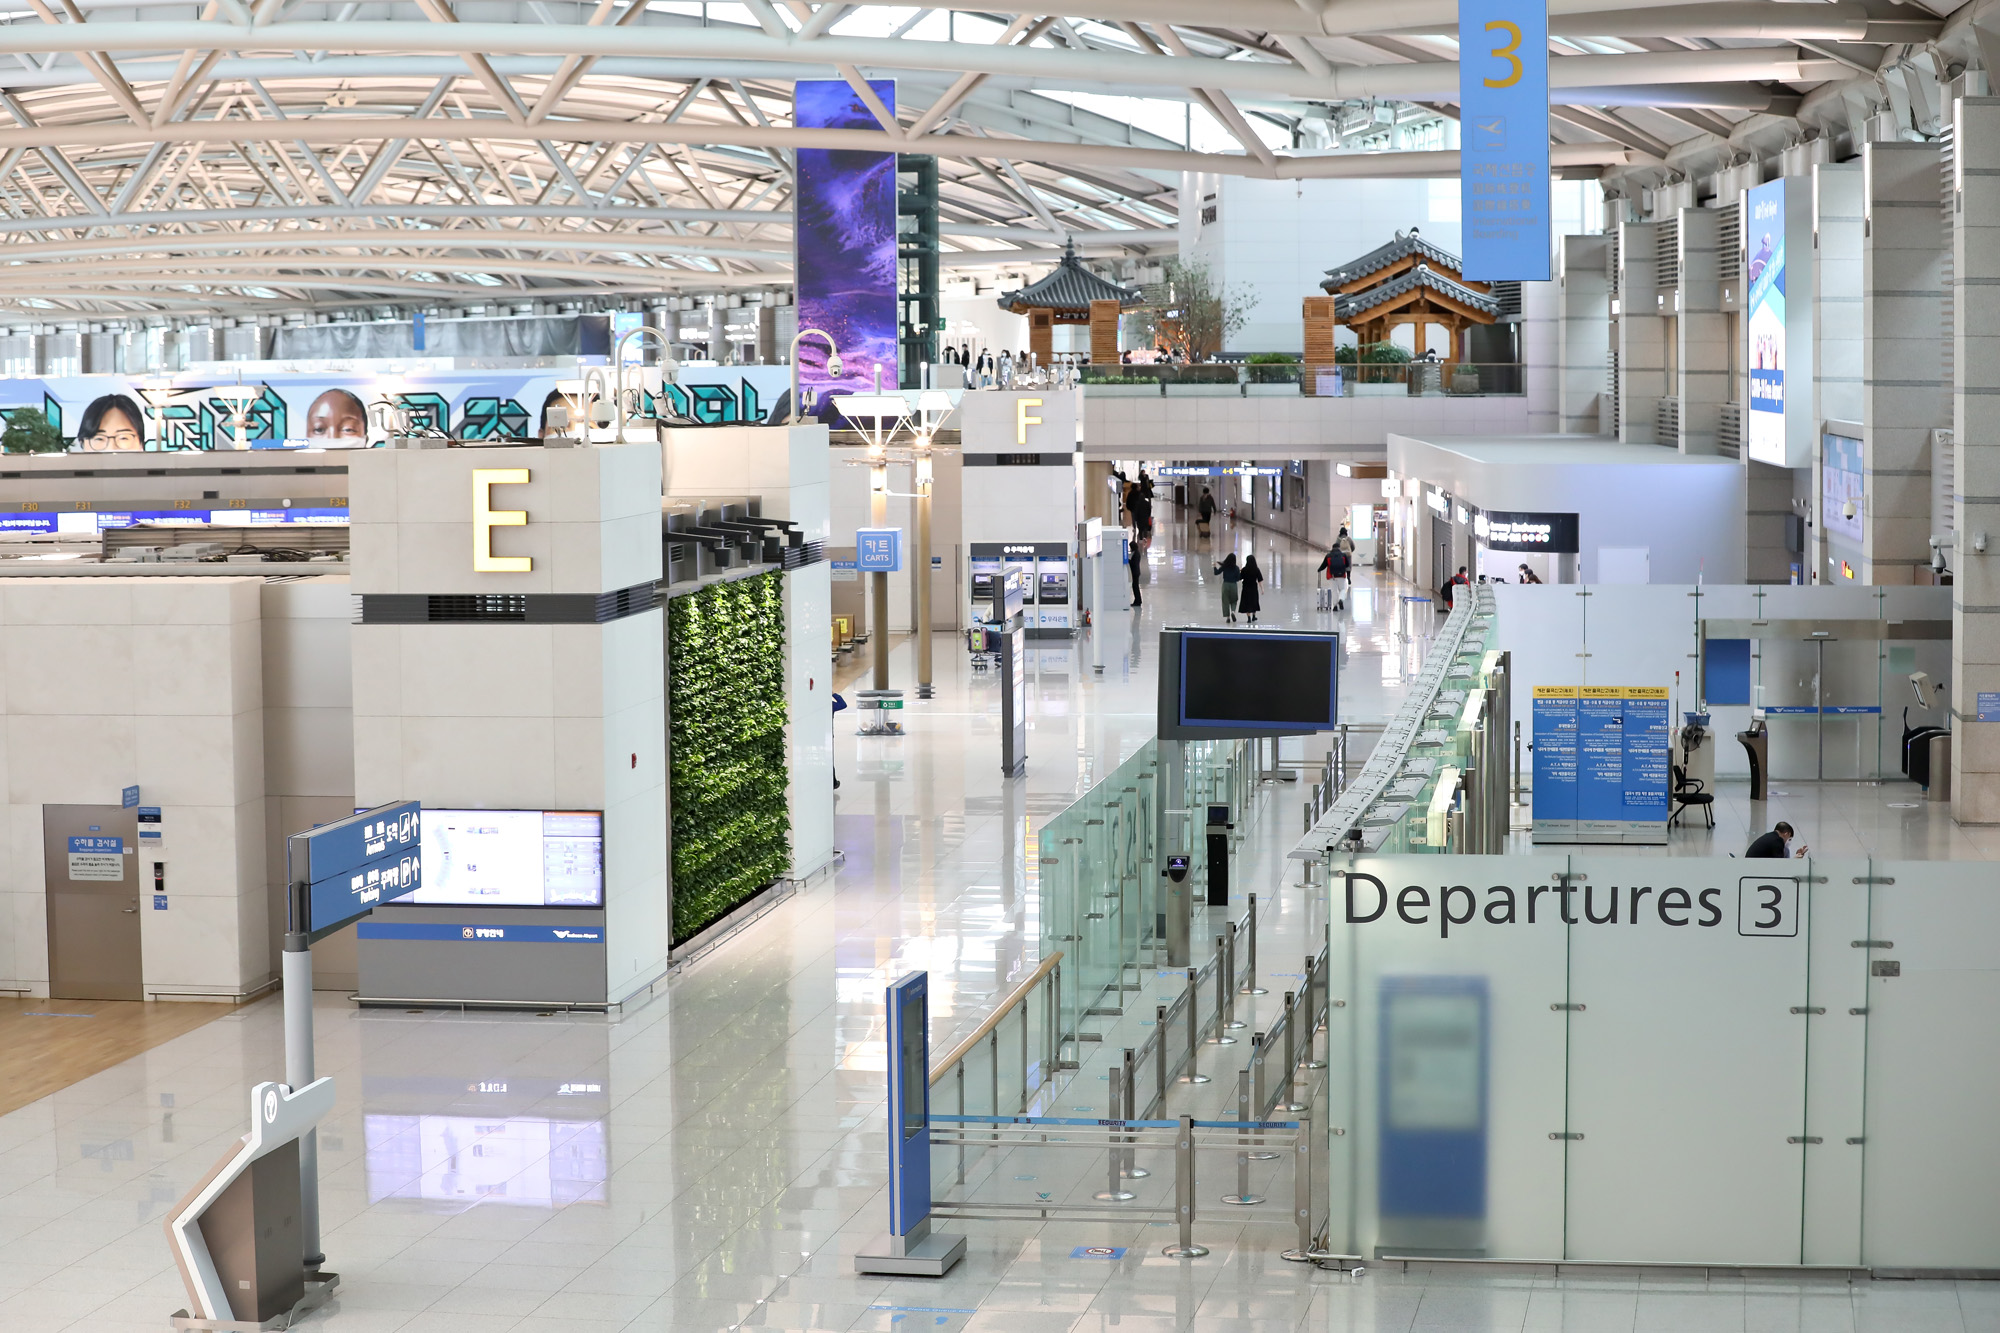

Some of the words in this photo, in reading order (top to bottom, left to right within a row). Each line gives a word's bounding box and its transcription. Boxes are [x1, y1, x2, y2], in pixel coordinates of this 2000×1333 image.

[1483, 20, 1524, 89] 3
[1473, 162, 1536, 177] 국제선탑승
[1473, 216, 1538, 226] International
[1473, 229, 1519, 240] Boarding
[1017, 398, 1043, 444] F
[22, 502, 38, 511] F30
[76, 502, 91, 510] F31
[174, 500, 190, 509] F32
[229, 500, 246, 508] F33
[330, 498, 346, 506] F34
[471, 468, 533, 573] E
[865, 540, 888, 552] 카트
[74, 838, 94, 847] 수하물
[96, 839, 117, 847] 검사실
[1345, 873, 1723, 938] Departures
[1755, 885, 1783, 929] 3
